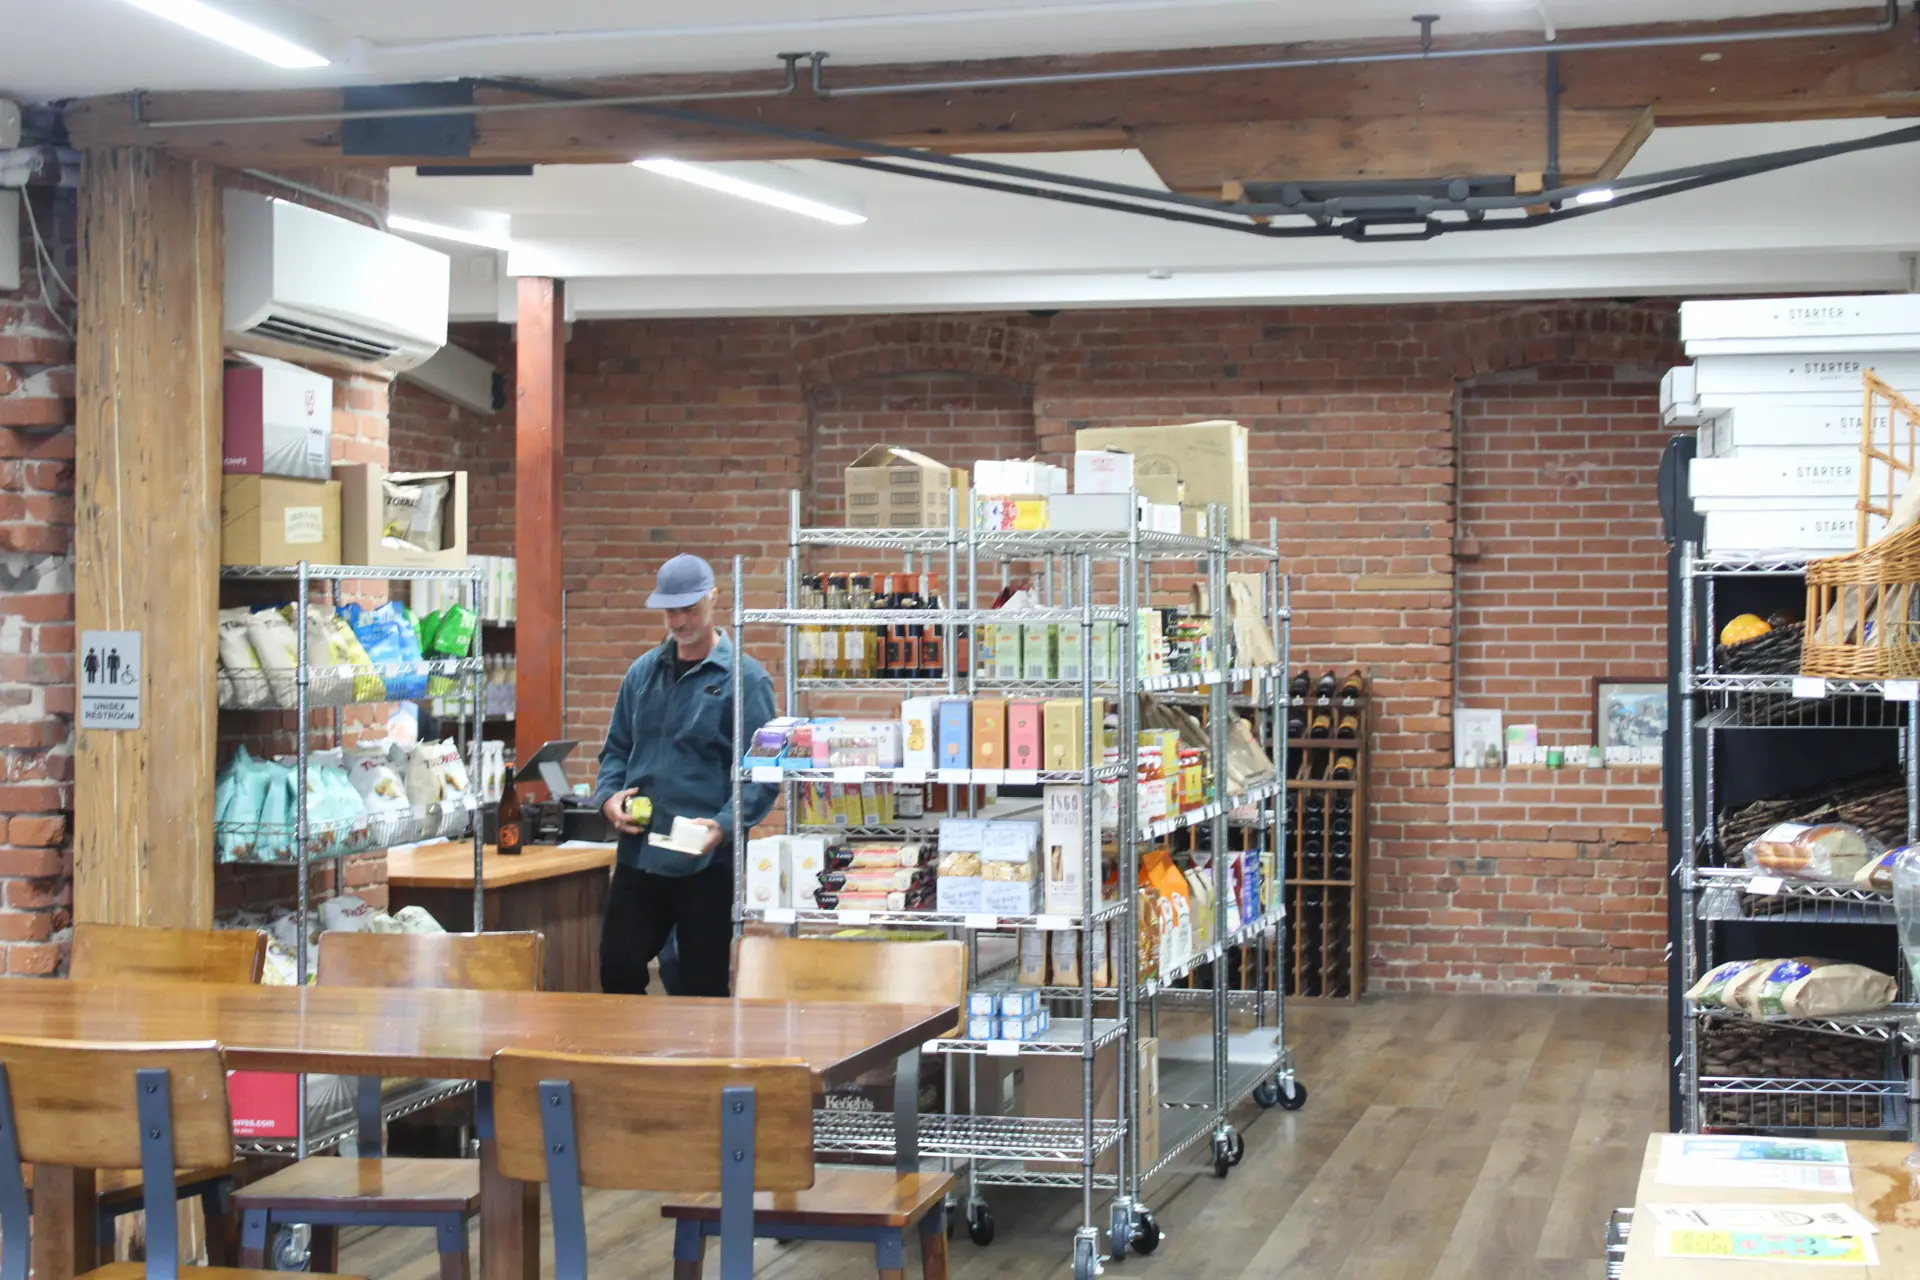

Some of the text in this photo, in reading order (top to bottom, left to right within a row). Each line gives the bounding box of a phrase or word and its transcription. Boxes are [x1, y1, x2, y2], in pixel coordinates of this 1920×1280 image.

[1788, 307, 1844, 320] STARTER
[1804, 362, 1860, 374] STARTER
[1840, 416, 1888, 429] STATE
[1797, 466, 1852, 478] STARTER
[1815, 520, 1855, 532] START
[93, 702, 126, 711] UNISEX
[85, 711, 135, 720] RESTROOM
